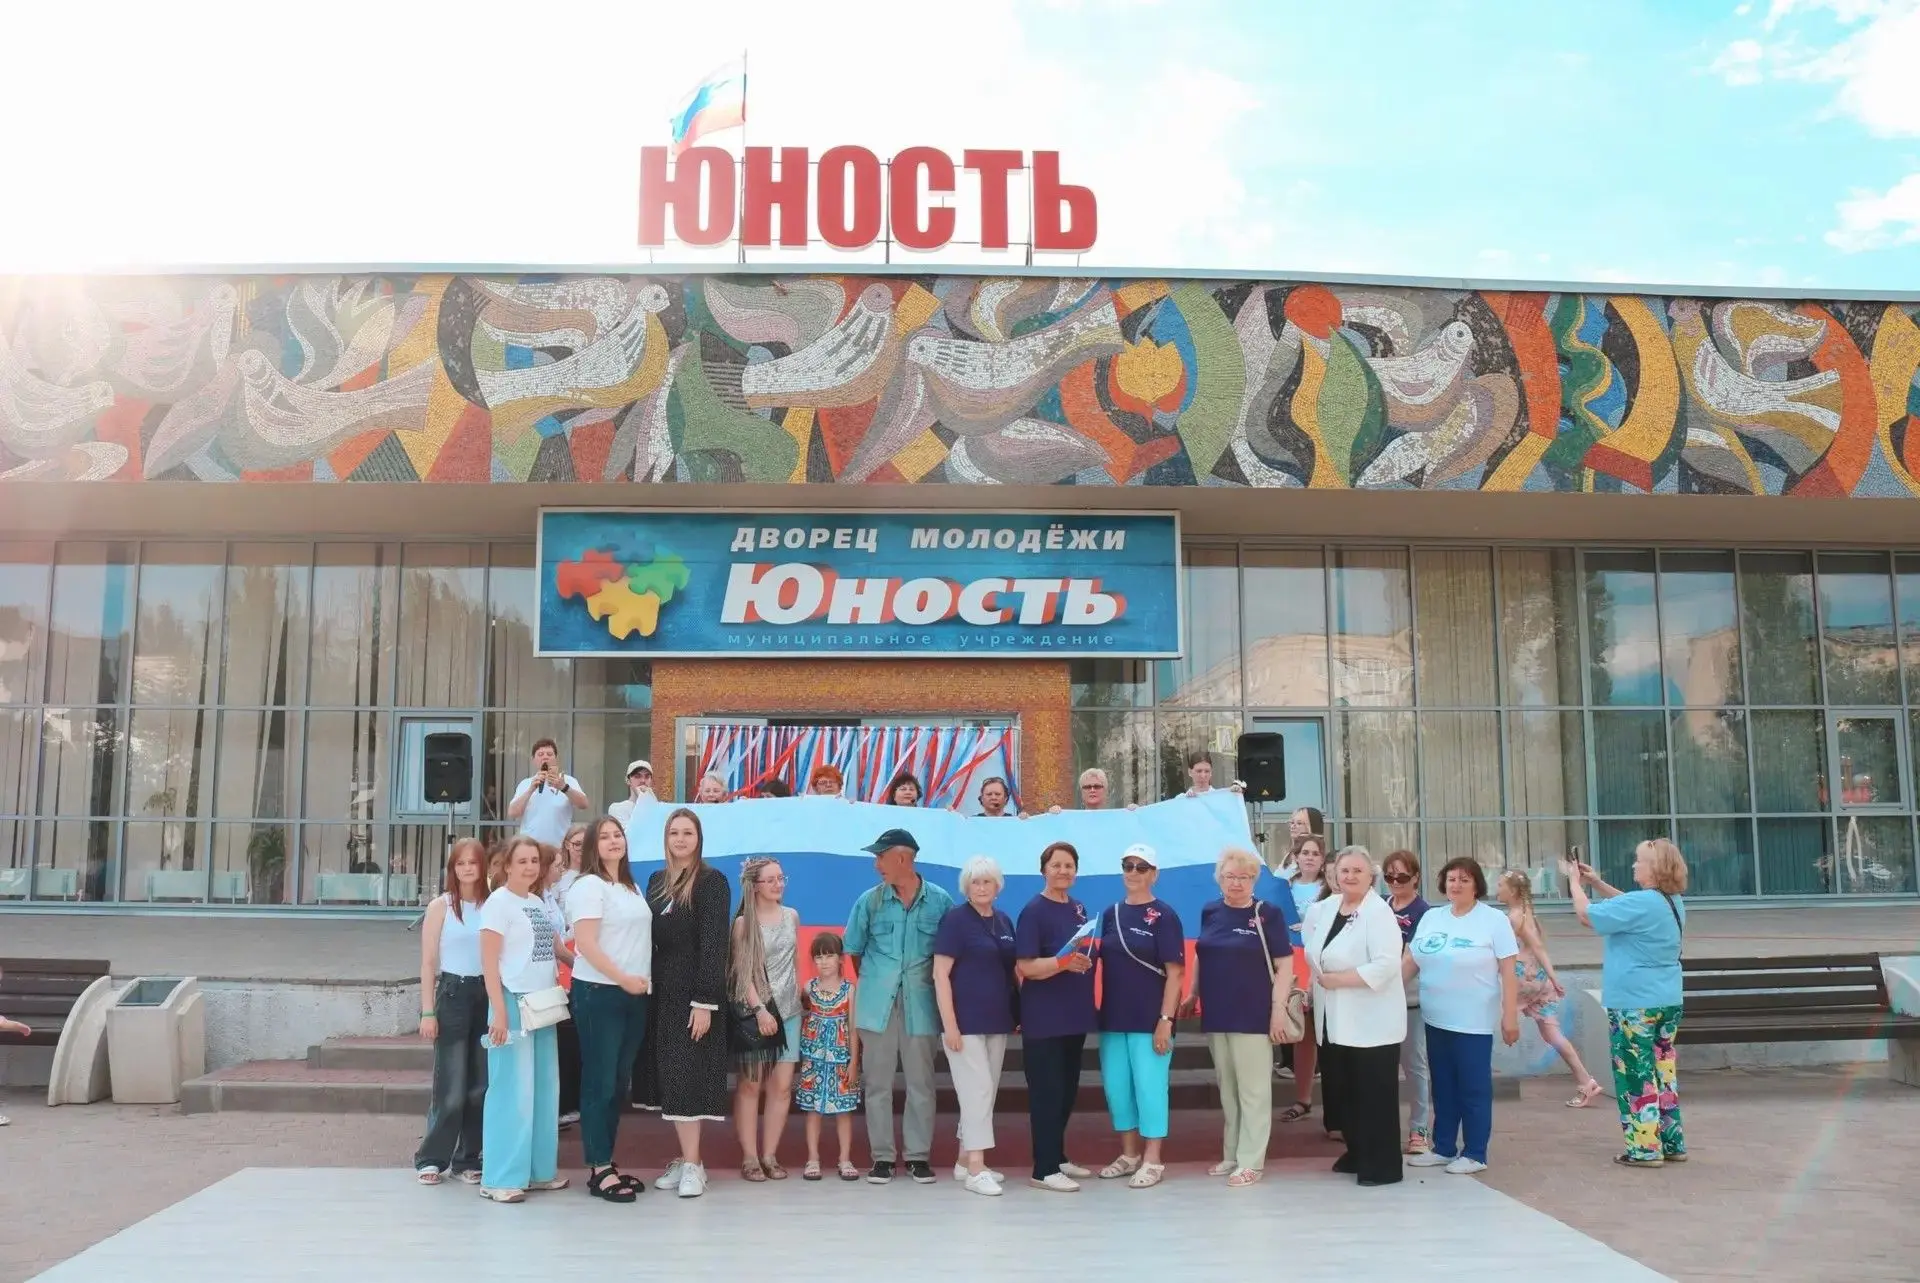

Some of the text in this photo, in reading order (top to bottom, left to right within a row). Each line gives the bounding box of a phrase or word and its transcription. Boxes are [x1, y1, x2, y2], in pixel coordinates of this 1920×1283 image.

[638, 145, 1097, 253] ЮНОСТЬ
[730, 523, 1127, 553] ДВОРЕЦ МОЛОДЁЖИ
[719, 562, 1120, 626] Юность
[727, 633, 1114, 647] муниципальное учреждение
